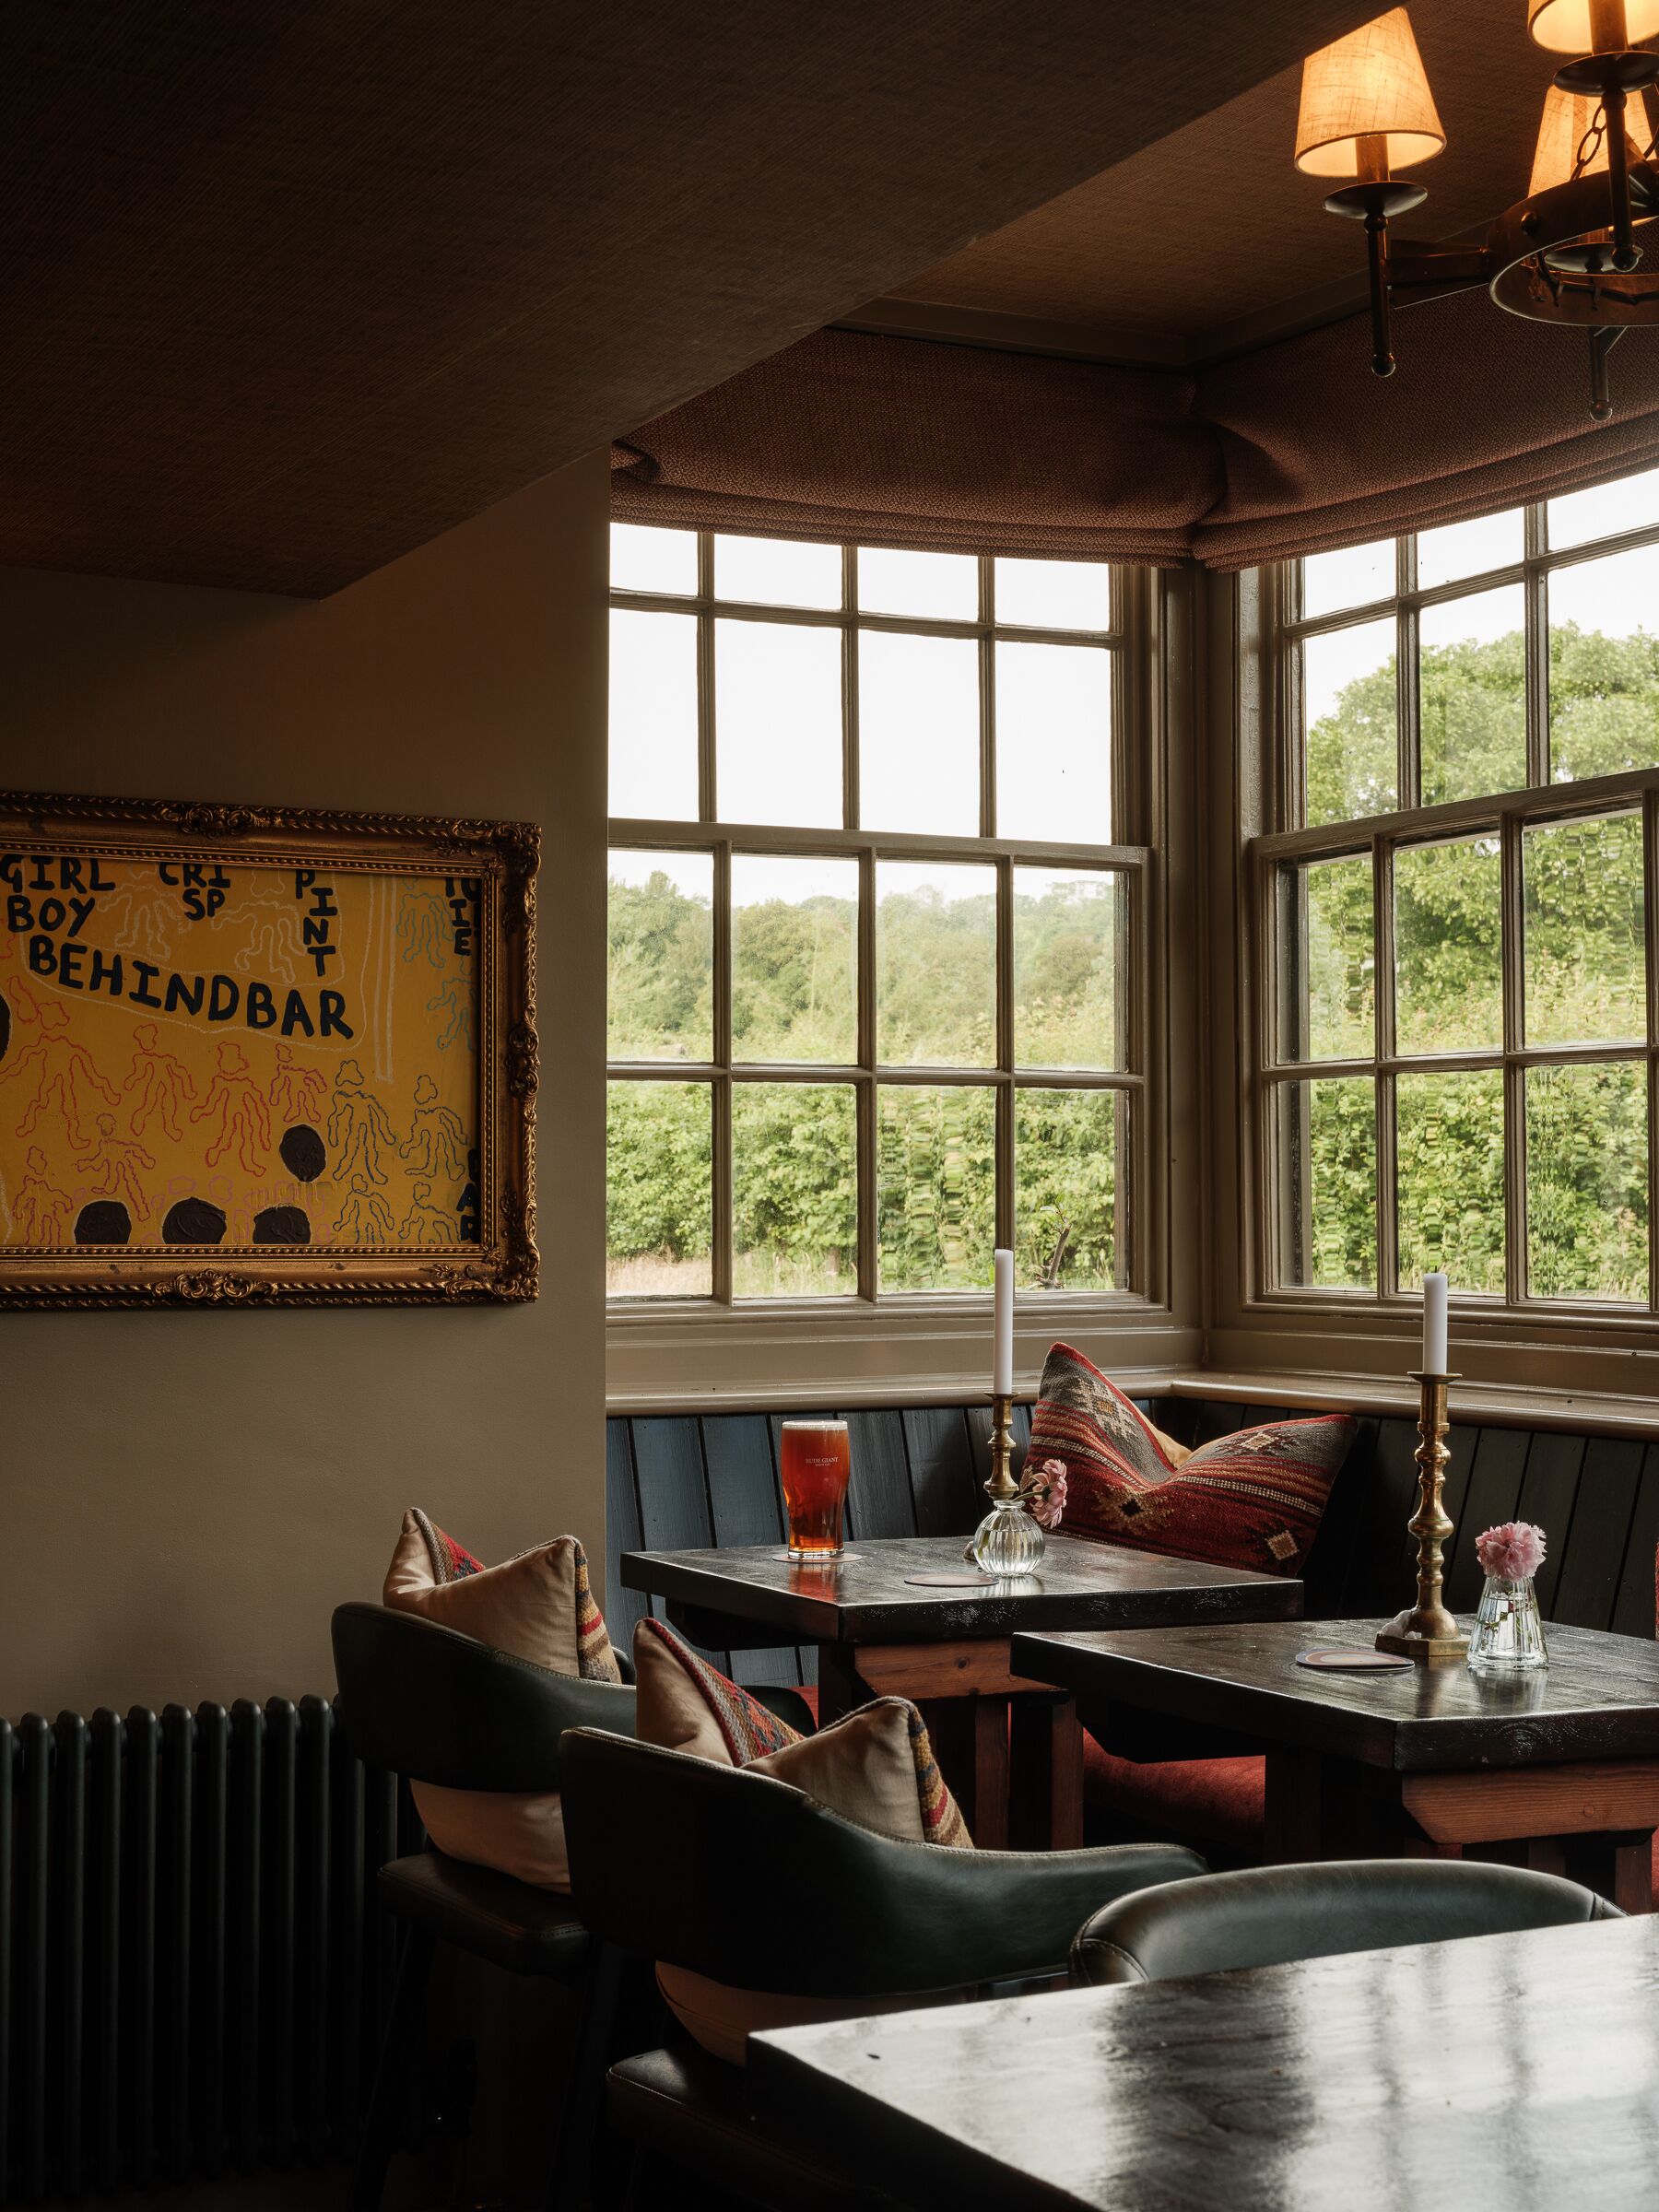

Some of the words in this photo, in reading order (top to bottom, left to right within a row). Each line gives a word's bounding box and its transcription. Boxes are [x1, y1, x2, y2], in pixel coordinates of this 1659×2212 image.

[0, 854, 116, 894] GIRL
[7, 895, 95, 937] BOY
[182, 888, 225, 921] SP
